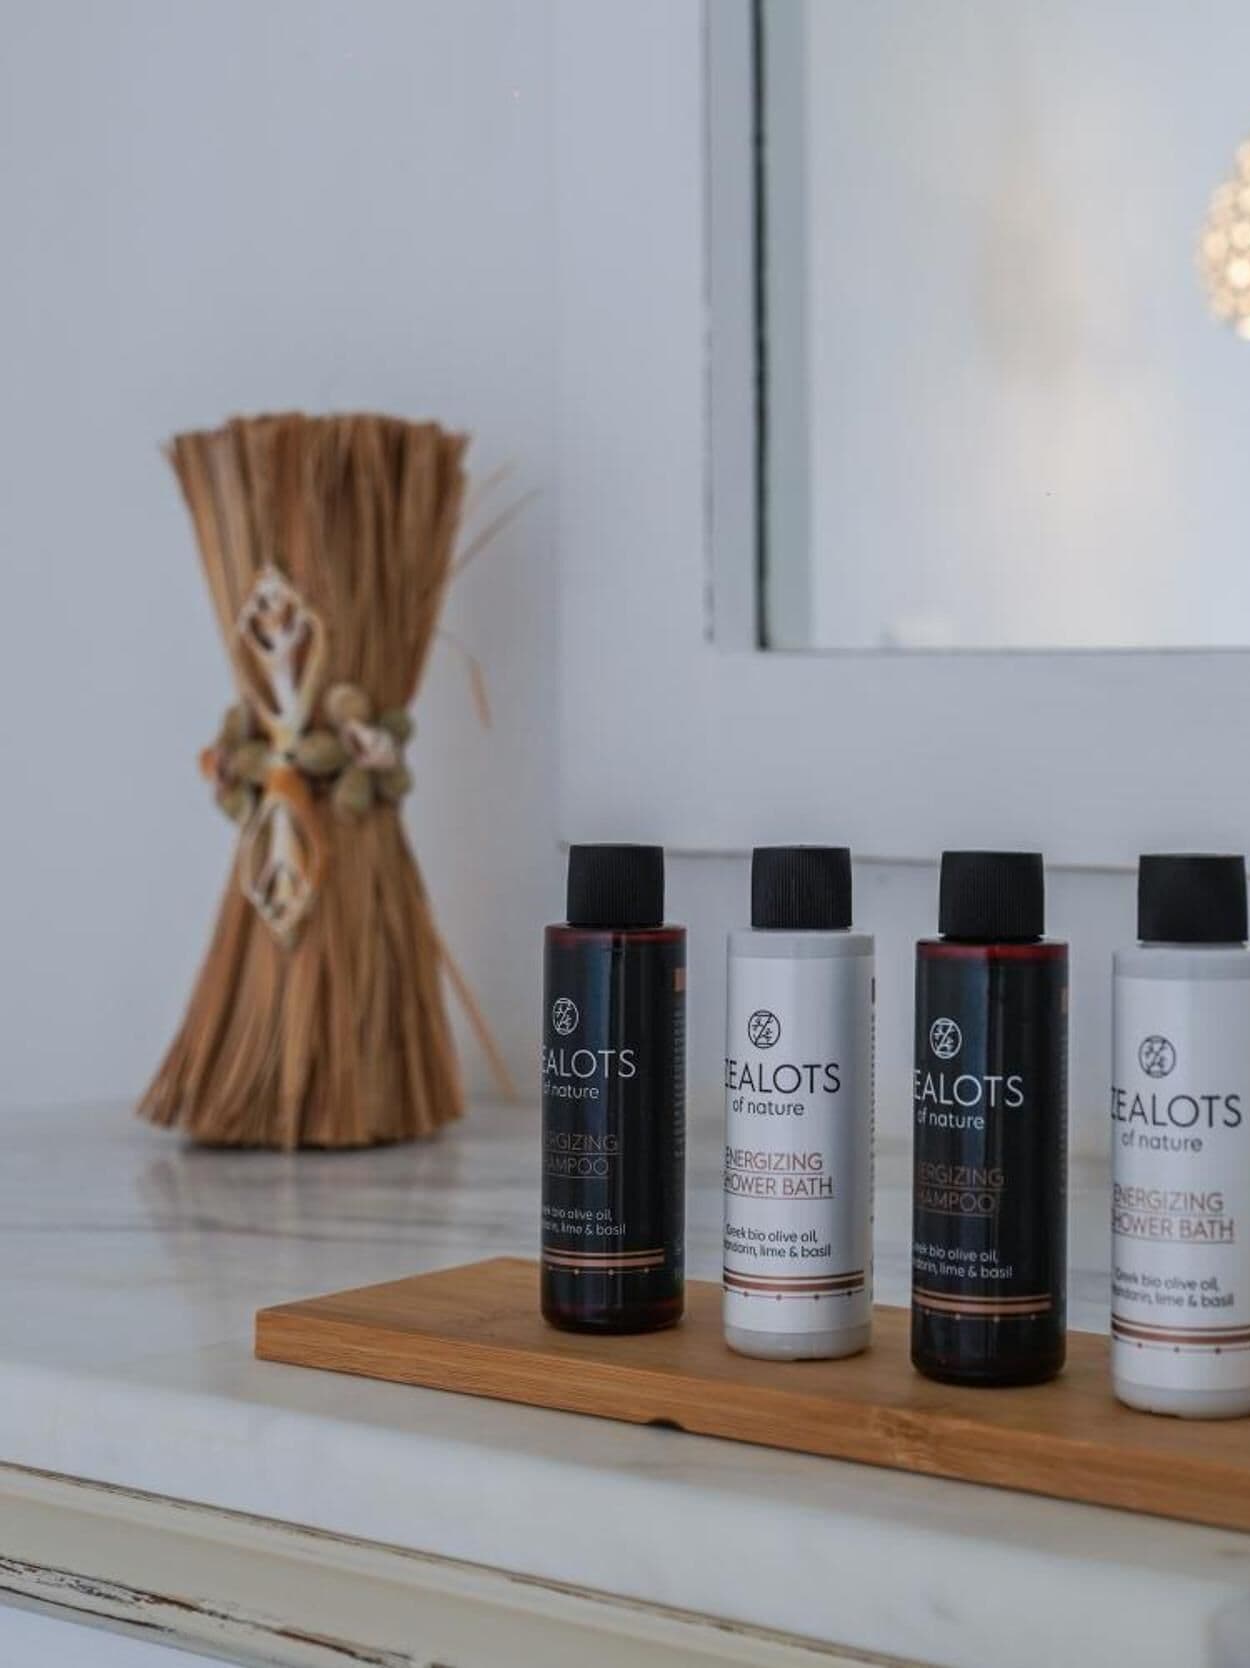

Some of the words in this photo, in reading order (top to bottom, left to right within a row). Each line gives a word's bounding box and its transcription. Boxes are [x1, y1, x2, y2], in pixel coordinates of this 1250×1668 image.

[552, 1084, 600, 1100] nature
[732, 1096, 744, 1112] of
[748, 1101, 804, 1116] nature
[929, 1111, 985, 1130] nature
[1121, 1129, 1135, 1147] of
[1138, 1135, 1203, 1153] nature
[782, 1176, 833, 1196] BATH
[595, 1223, 626, 1236] basil
[747, 1228, 766, 1242] bio
[768, 1230, 798, 1243] olive
[1179, 1218, 1235, 1240] BATH
[760, 1244, 786, 1257] lime
[789, 1248, 799, 1258] &
[801, 1243, 832, 1258] basil
[947, 1247, 977, 1262] olive
[939, 1261, 965, 1277] lime
[967, 1265, 977, 1278] &
[980, 1265, 1013, 1279] basil
[1141, 1273, 1162, 1289] bio
[1164, 1276, 1198, 1291] olive
[1155, 1292, 1184, 1307] lime
[1187, 1294, 1198, 1308] &
[1201, 1292, 1235, 1309] basil
